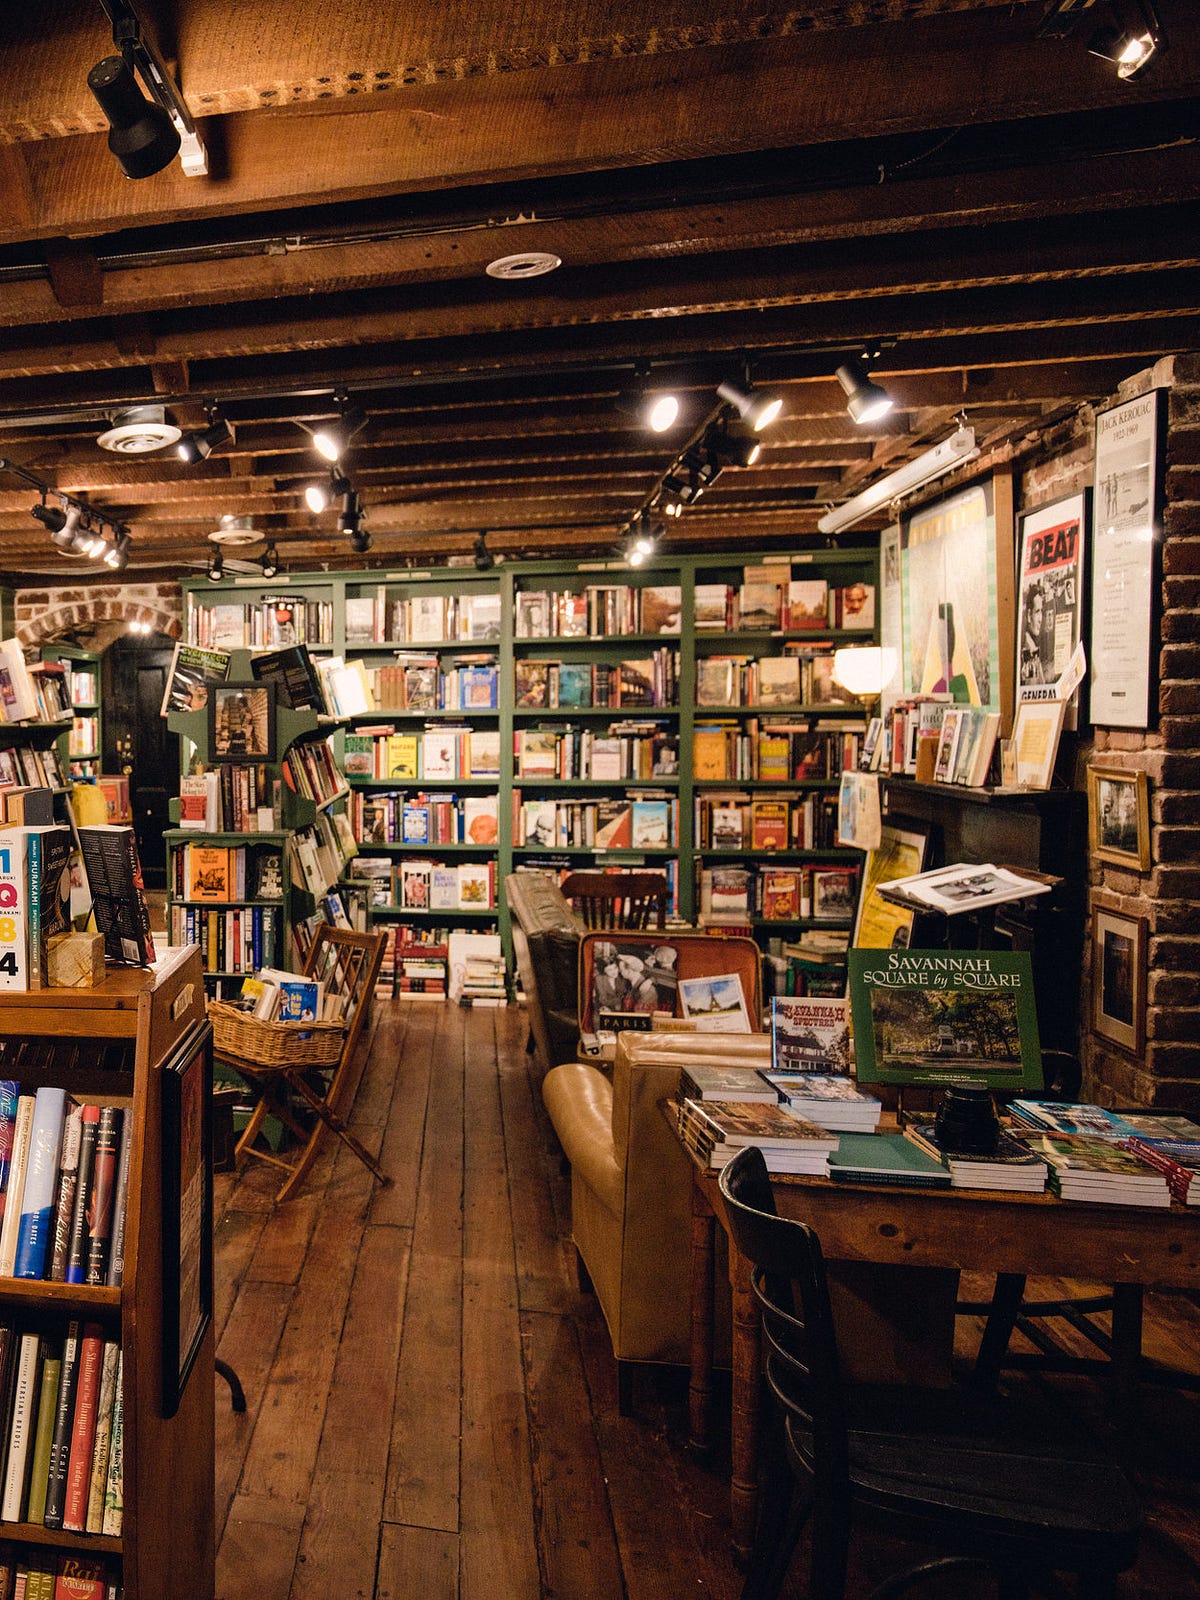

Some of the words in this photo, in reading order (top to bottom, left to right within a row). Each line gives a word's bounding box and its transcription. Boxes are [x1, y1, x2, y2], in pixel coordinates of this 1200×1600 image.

[1102, 416, 1117, 434] JACK
[1118, 401, 1151, 423] KEROUAC
[1029, 524, 1080, 570] BEAT
[182, 647, 228, 664] evergreen
[888, 953, 992, 972] SAVANNAH
[863, 971, 928, 988] SQUARE
[933, 973, 949, 989] by
[953, 972, 1022, 990] SQUARE
[603, 1017, 647, 1028] PARIS
[784, 1004, 846, 1022] SAVANNAH
[793, 1017, 835, 1027] SPECTRES
[58, 1175, 71, 1214] Ghost
[30, 1224, 40, 1245] OATES
[54, 1217, 68, 1252] Light
[86, 1354, 97, 1383] Shadow
[17, 1380, 27, 1416] PERSIAN
[13, 1418, 23, 1449] BRIDES
[100, 1432, 108, 1441] No
[48, 1443, 58, 1479] Raine
[57, 1445, 69, 1480] Craig
[98, 1442, 107, 1463] Holly
